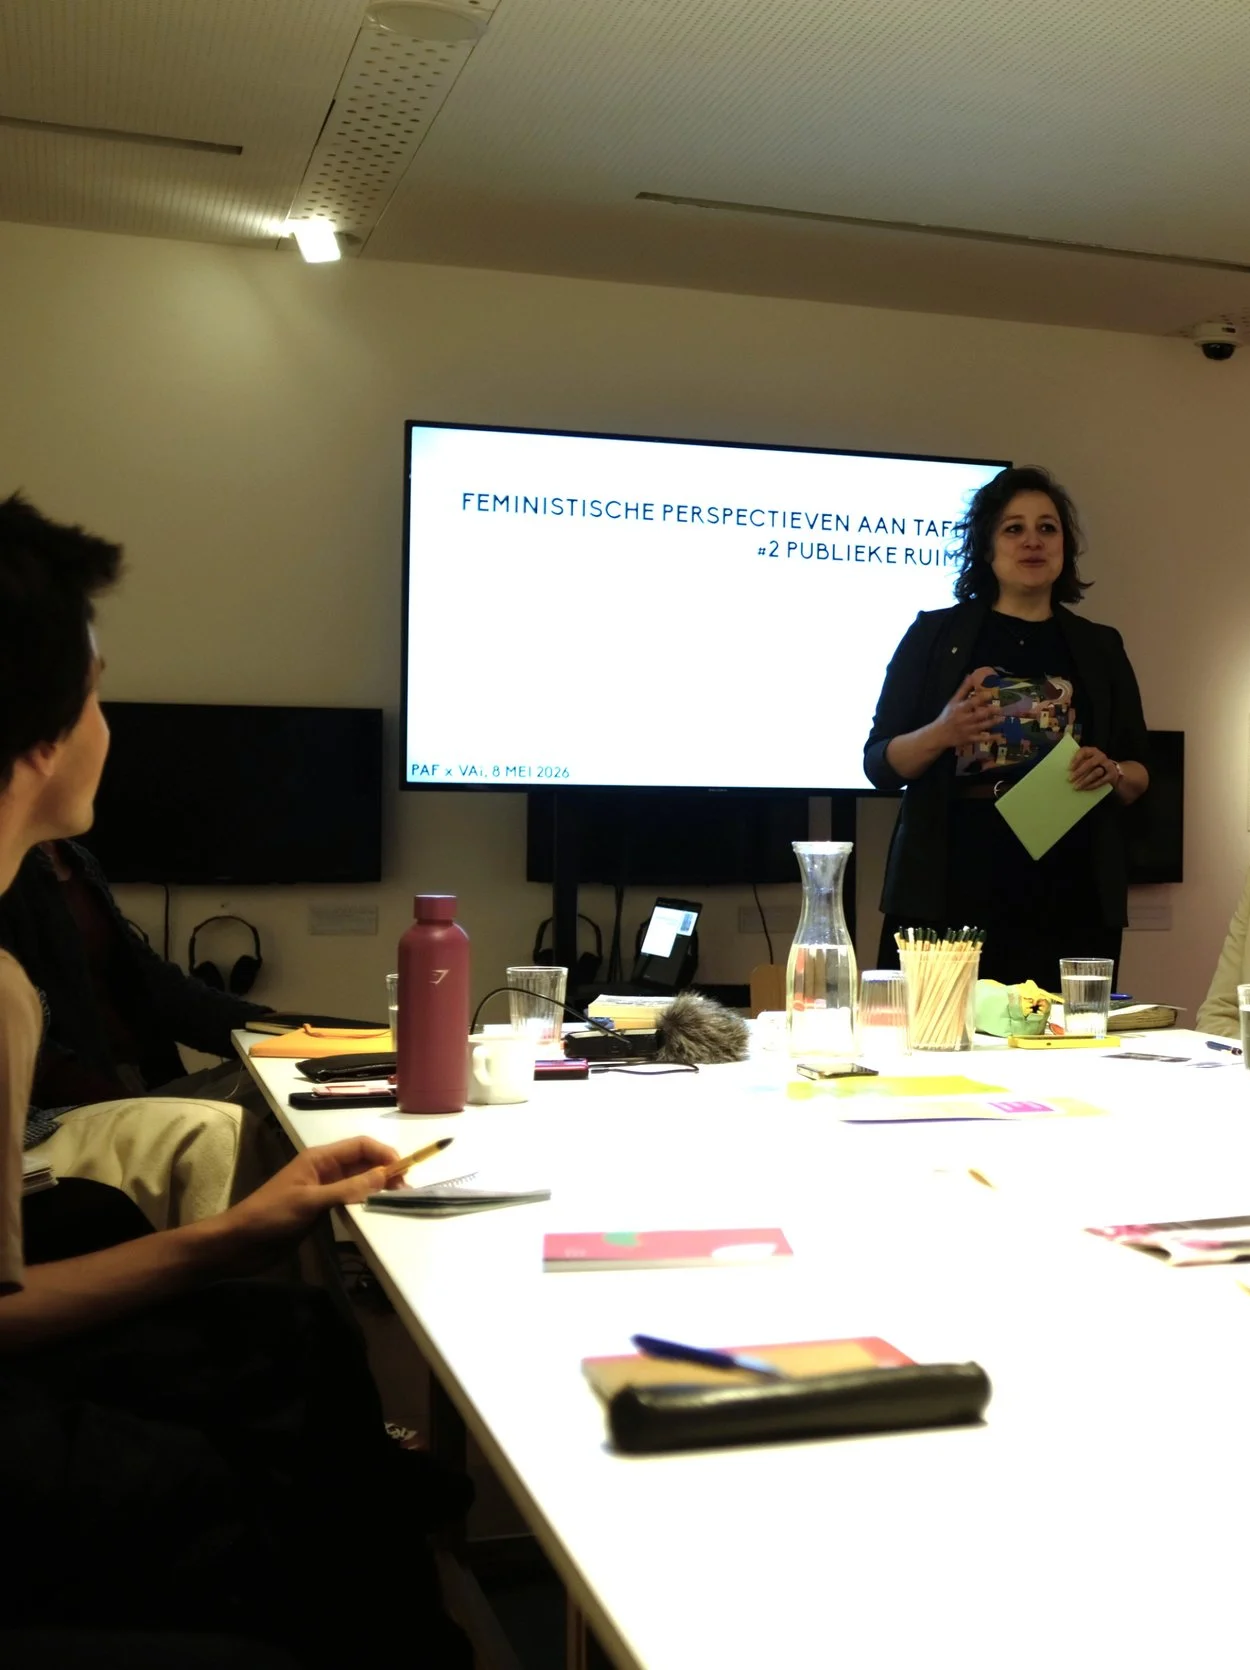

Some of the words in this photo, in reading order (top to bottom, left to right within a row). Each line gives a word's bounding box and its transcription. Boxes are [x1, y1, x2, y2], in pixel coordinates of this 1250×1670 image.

[462, 492, 655, 521] FEMINISTISCHE
[663, 504, 849, 532] PERSPECTIEVEN
[858, 516, 906, 535] AAN
[757, 540, 780, 558] #2
[787, 541, 898, 564] PUBLIEKE
[411, 764, 440, 776] PAF
[445, 768, 453, 777] x
[492, 765, 500, 778] 8
[505, 766, 531, 778] MEI
[537, 766, 570, 779] 2026
